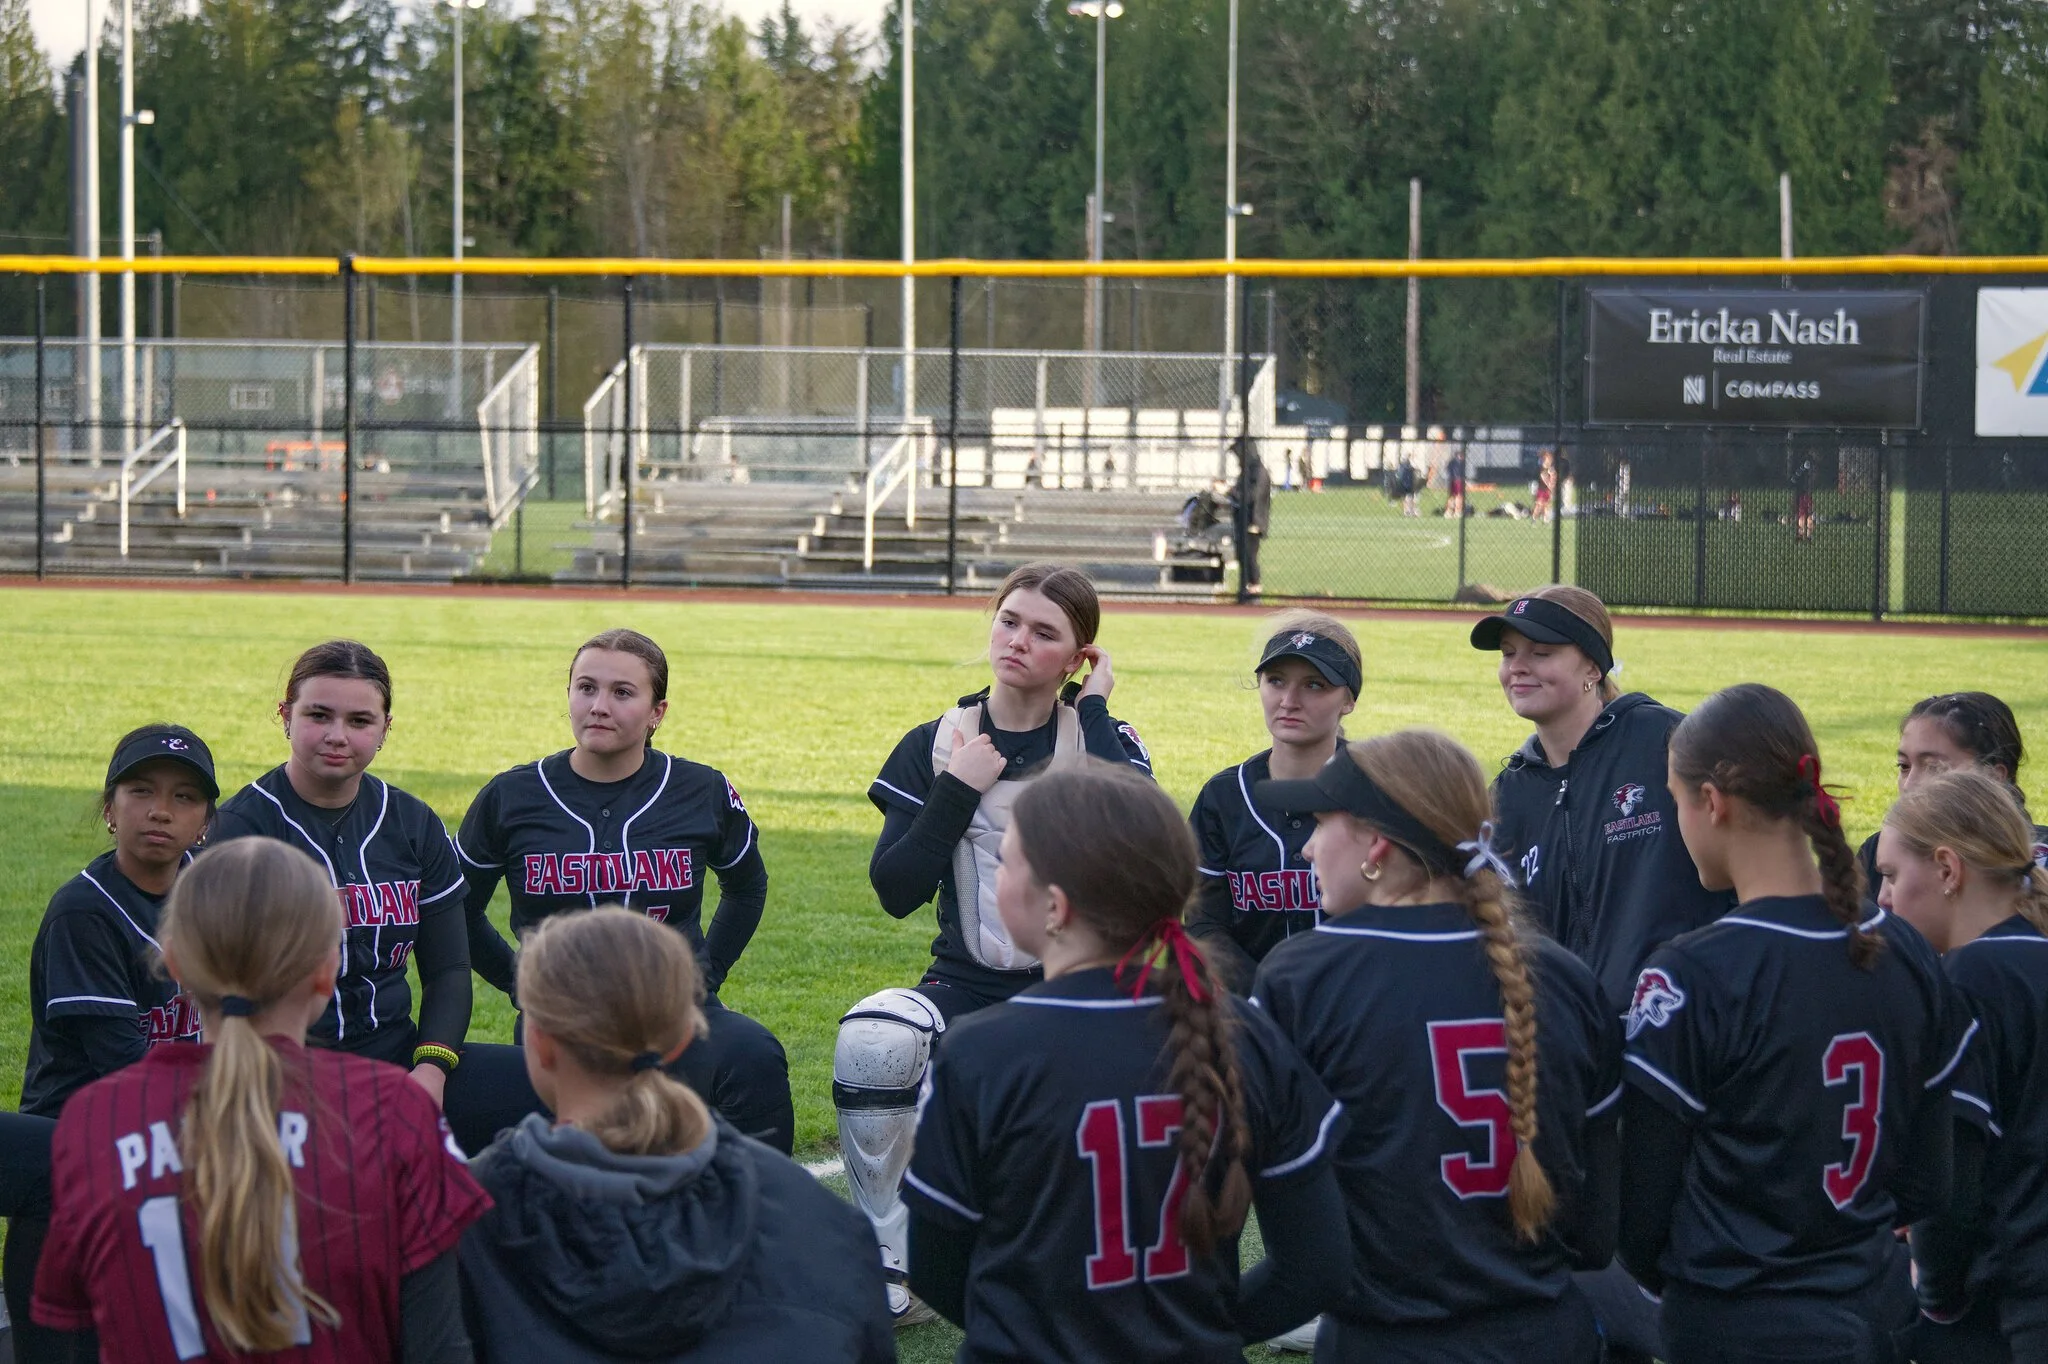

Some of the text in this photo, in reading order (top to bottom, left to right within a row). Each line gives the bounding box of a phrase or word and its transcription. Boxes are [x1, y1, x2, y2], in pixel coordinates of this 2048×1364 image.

[1648, 306, 1861, 345] Ericka Nash
[1713, 346, 1793, 364] Real Estate
[1725, 380, 1821, 399] COMPASS
[1604, 811, 1660, 835] EASTLAKE
[1607, 825, 1662, 845] FASTPITCH
[524, 848, 693, 894] EASTLAKE
[1226, 868, 1323, 911] EASTL
[1427, 1018, 1520, 1200] 5
[1822, 1031, 1885, 1211] 3
[116, 1111, 309, 1190] PAR
[1076, 1093, 1220, 1291] 17
